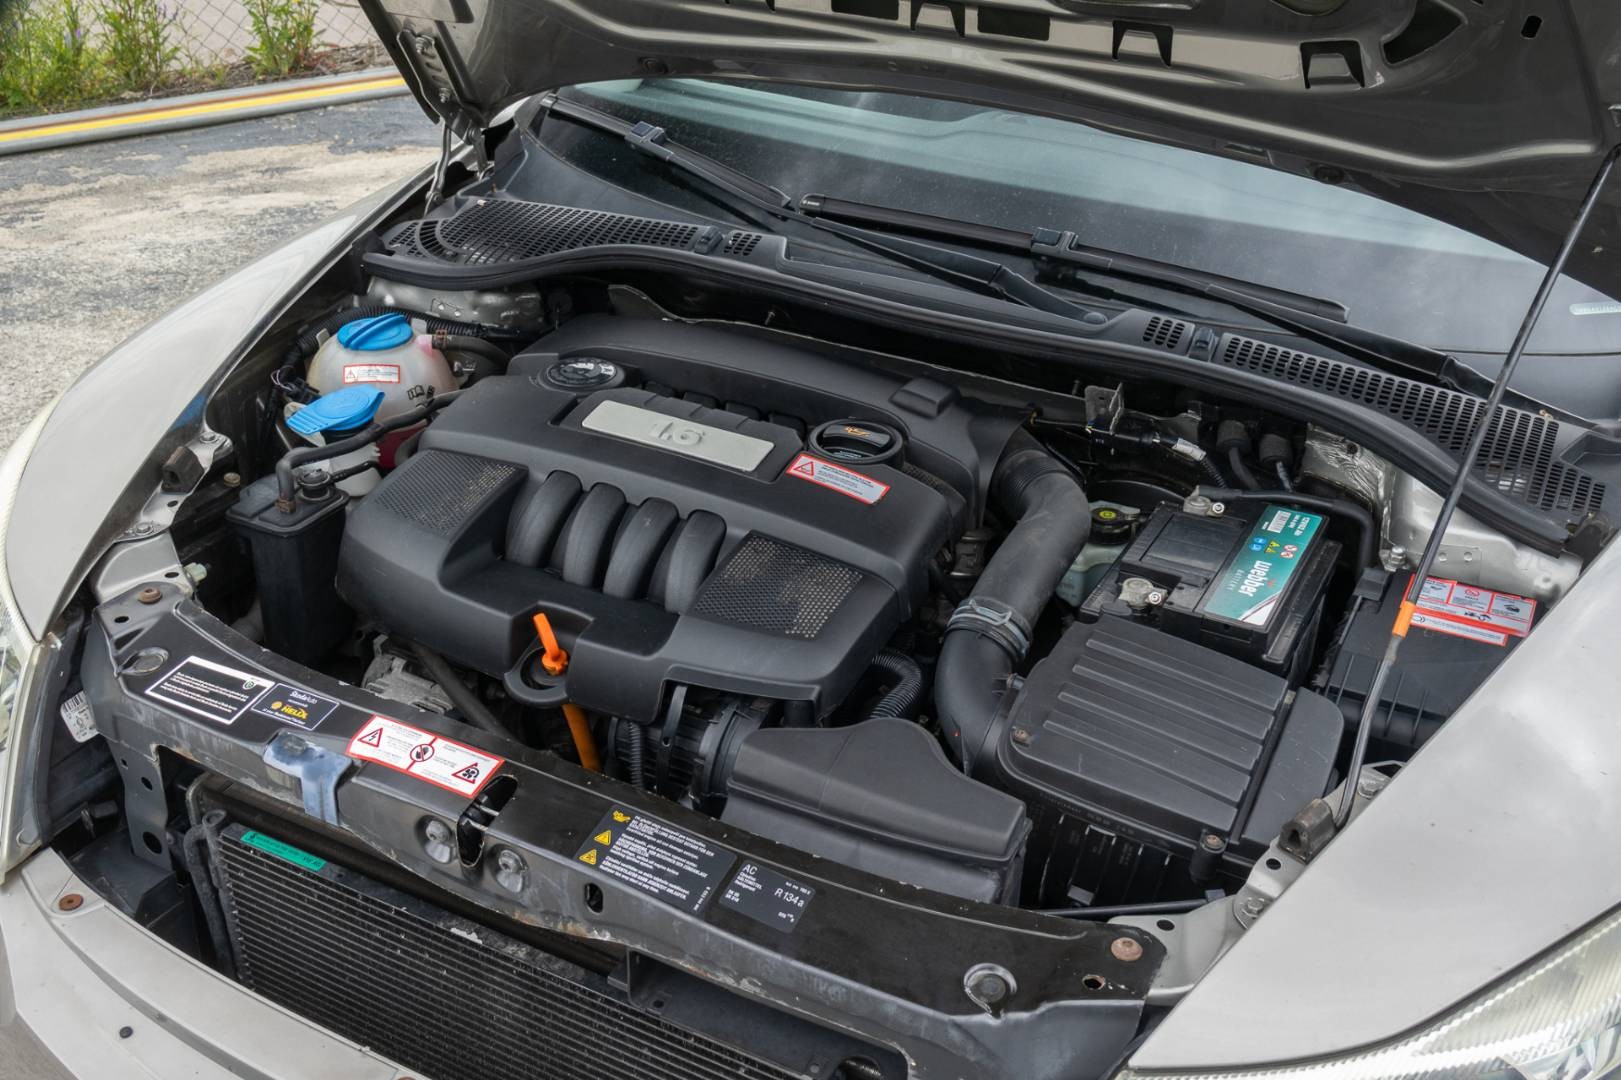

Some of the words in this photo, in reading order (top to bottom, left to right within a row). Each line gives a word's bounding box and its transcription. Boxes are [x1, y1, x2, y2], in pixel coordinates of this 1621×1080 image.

[1238, 560, 1272, 597] webber
[281, 706, 308, 719] HELIX
[742, 864, 757, 875] AC
